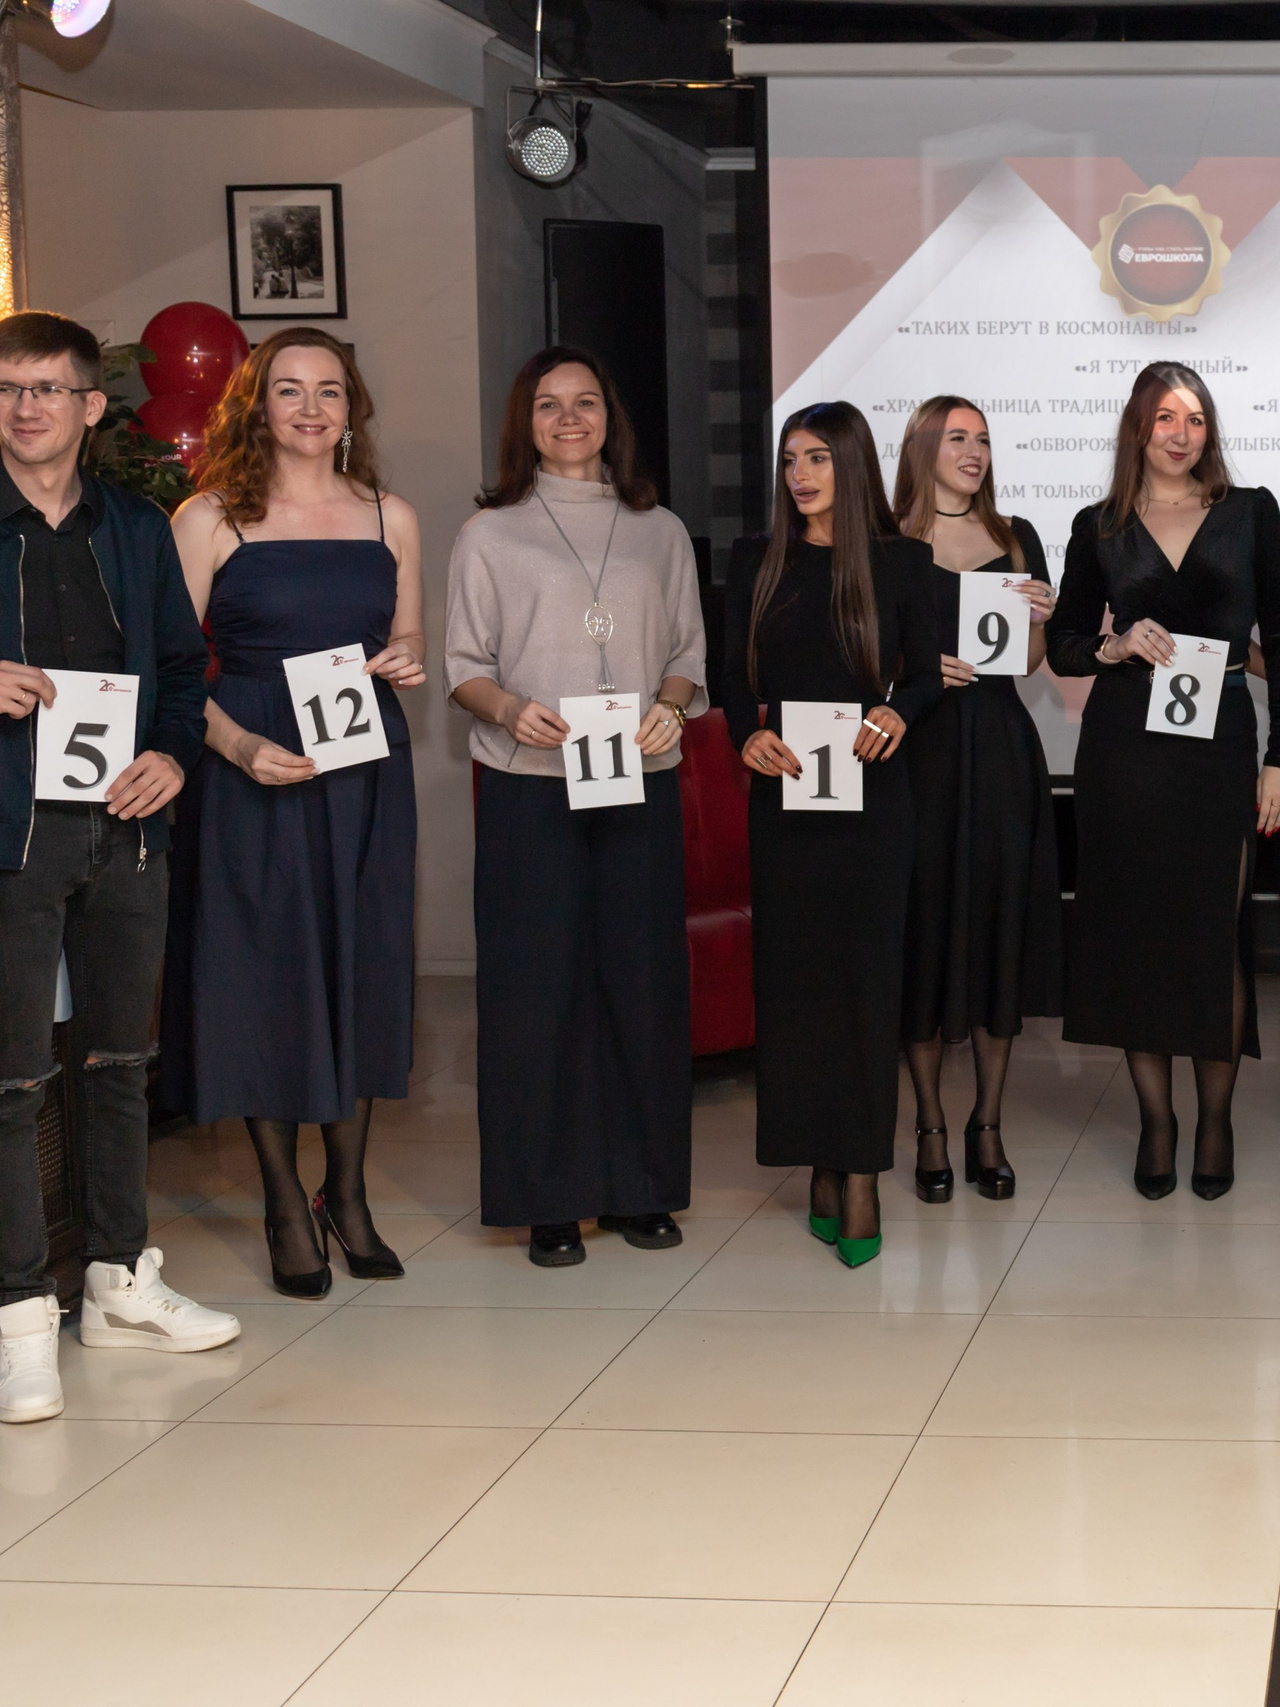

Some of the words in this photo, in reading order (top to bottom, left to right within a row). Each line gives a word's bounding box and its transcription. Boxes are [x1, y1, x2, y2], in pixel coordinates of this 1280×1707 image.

[1134, 253, 1204, 263] ЕВРОШКОЛА
[976, 320, 1032, 335] БЕРУТ
[1039, 320, 1050, 335] В
[1107, 359, 1141, 374] ТУТ
[1048, 399, 1126, 416] ТРАДИЦ
[1032, 484, 1103, 499] ТОЛЬКО
[976, 611, 1010, 666] 9
[302, 687, 371, 746] 12
[1164, 673, 1201, 727] 8
[63, 722, 109, 790] 5
[571, 732, 631, 782] 11
[808, 744, 839, 800] 1
